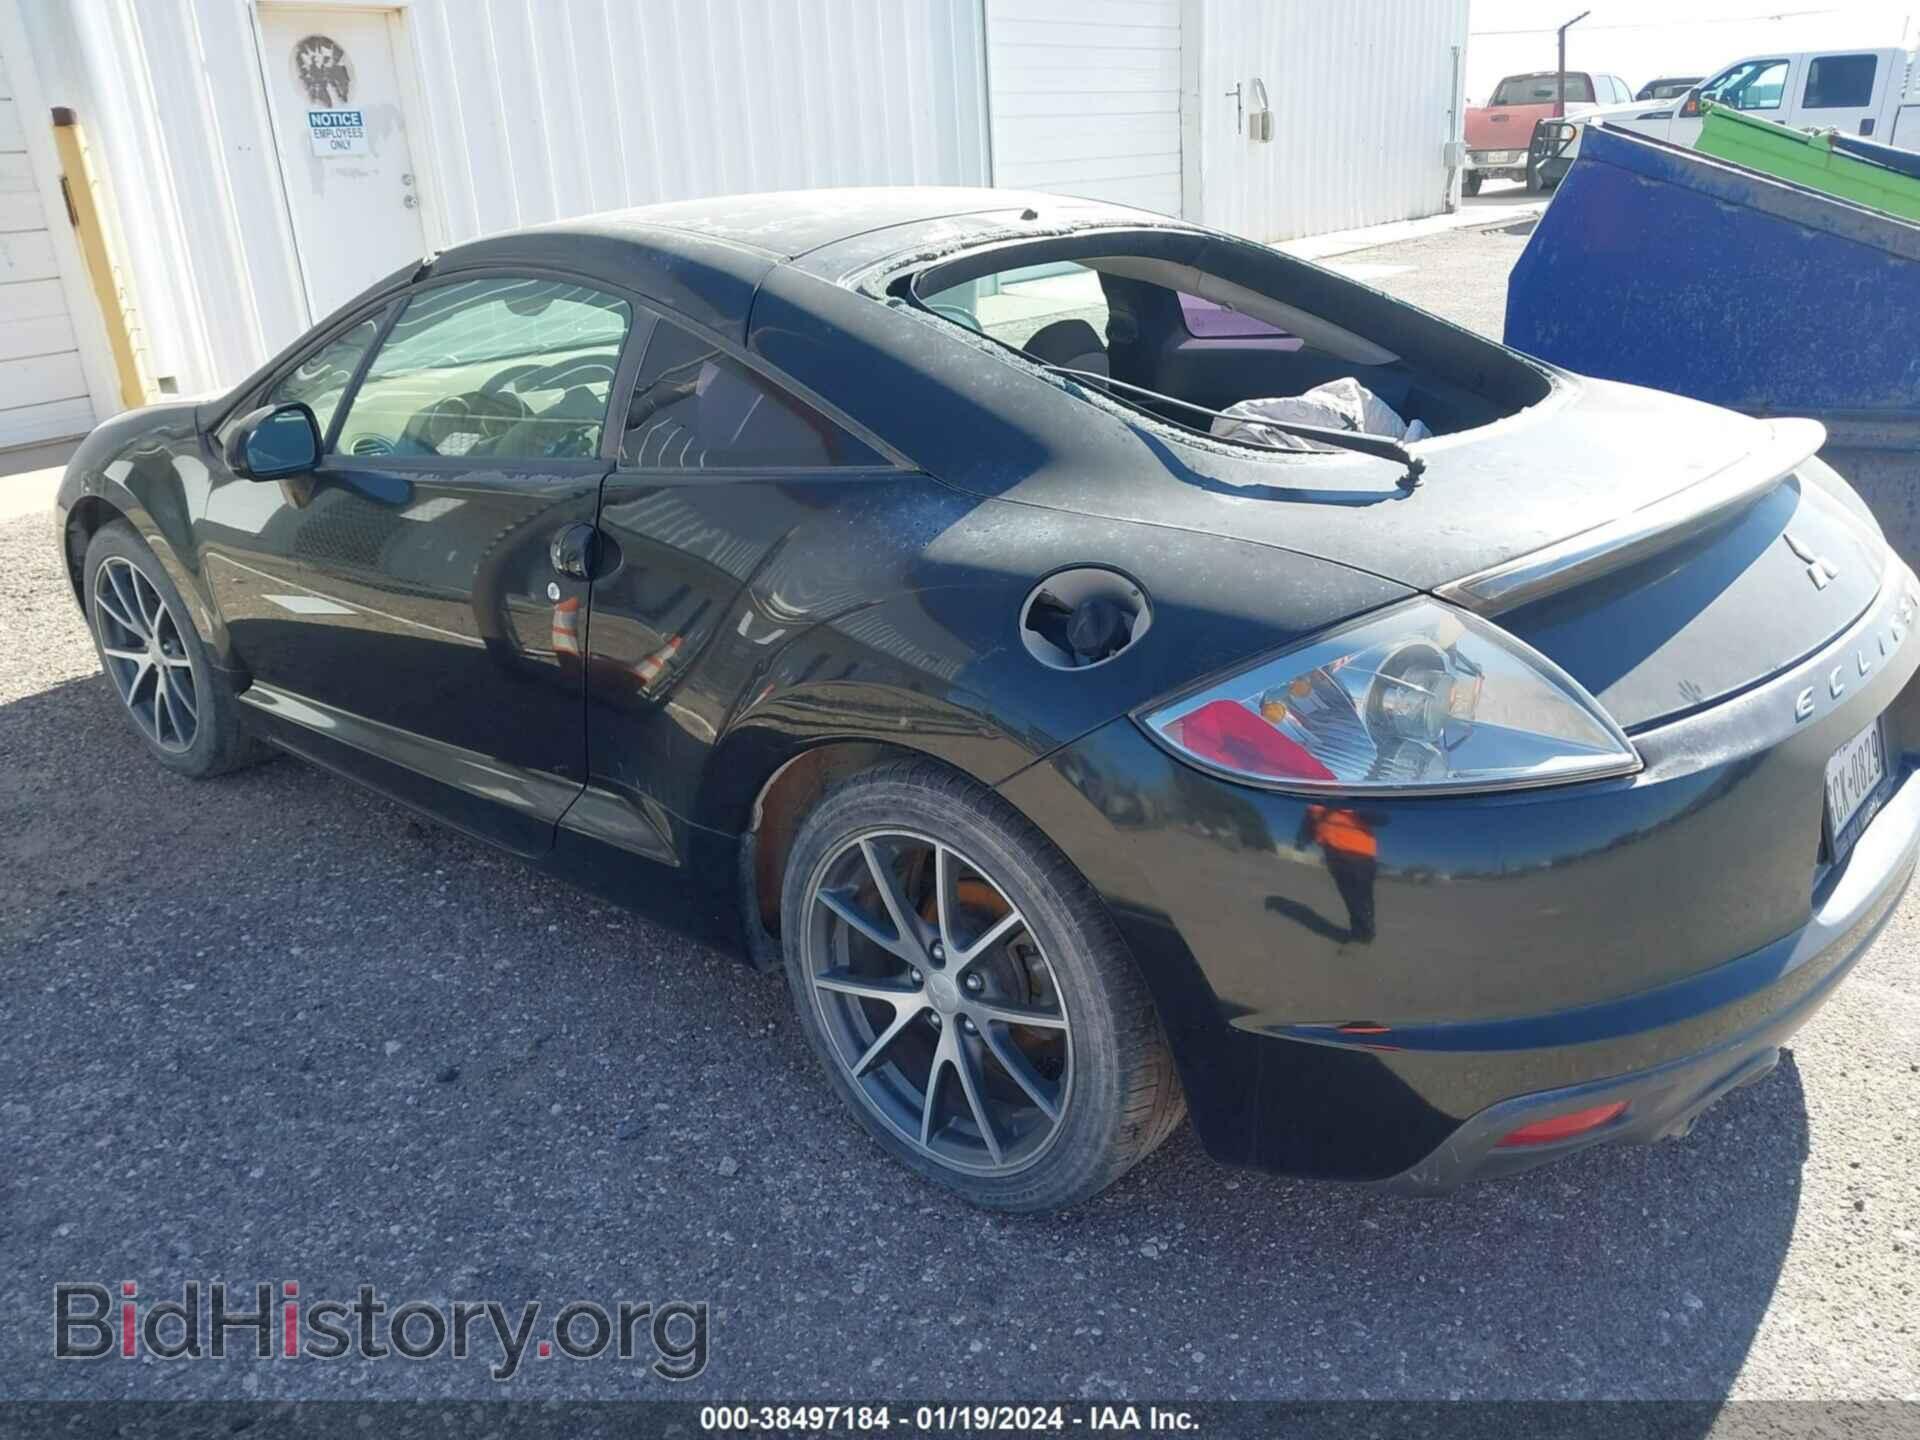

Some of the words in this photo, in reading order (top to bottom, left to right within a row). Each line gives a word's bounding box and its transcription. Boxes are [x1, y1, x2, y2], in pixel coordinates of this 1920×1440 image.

[310, 112, 361, 126] NOTICE
[313, 128, 363, 138] EMPLOYEES
[330, 140, 351, 150] ONLY
[1794, 588, 1920, 724] ECLIPS
